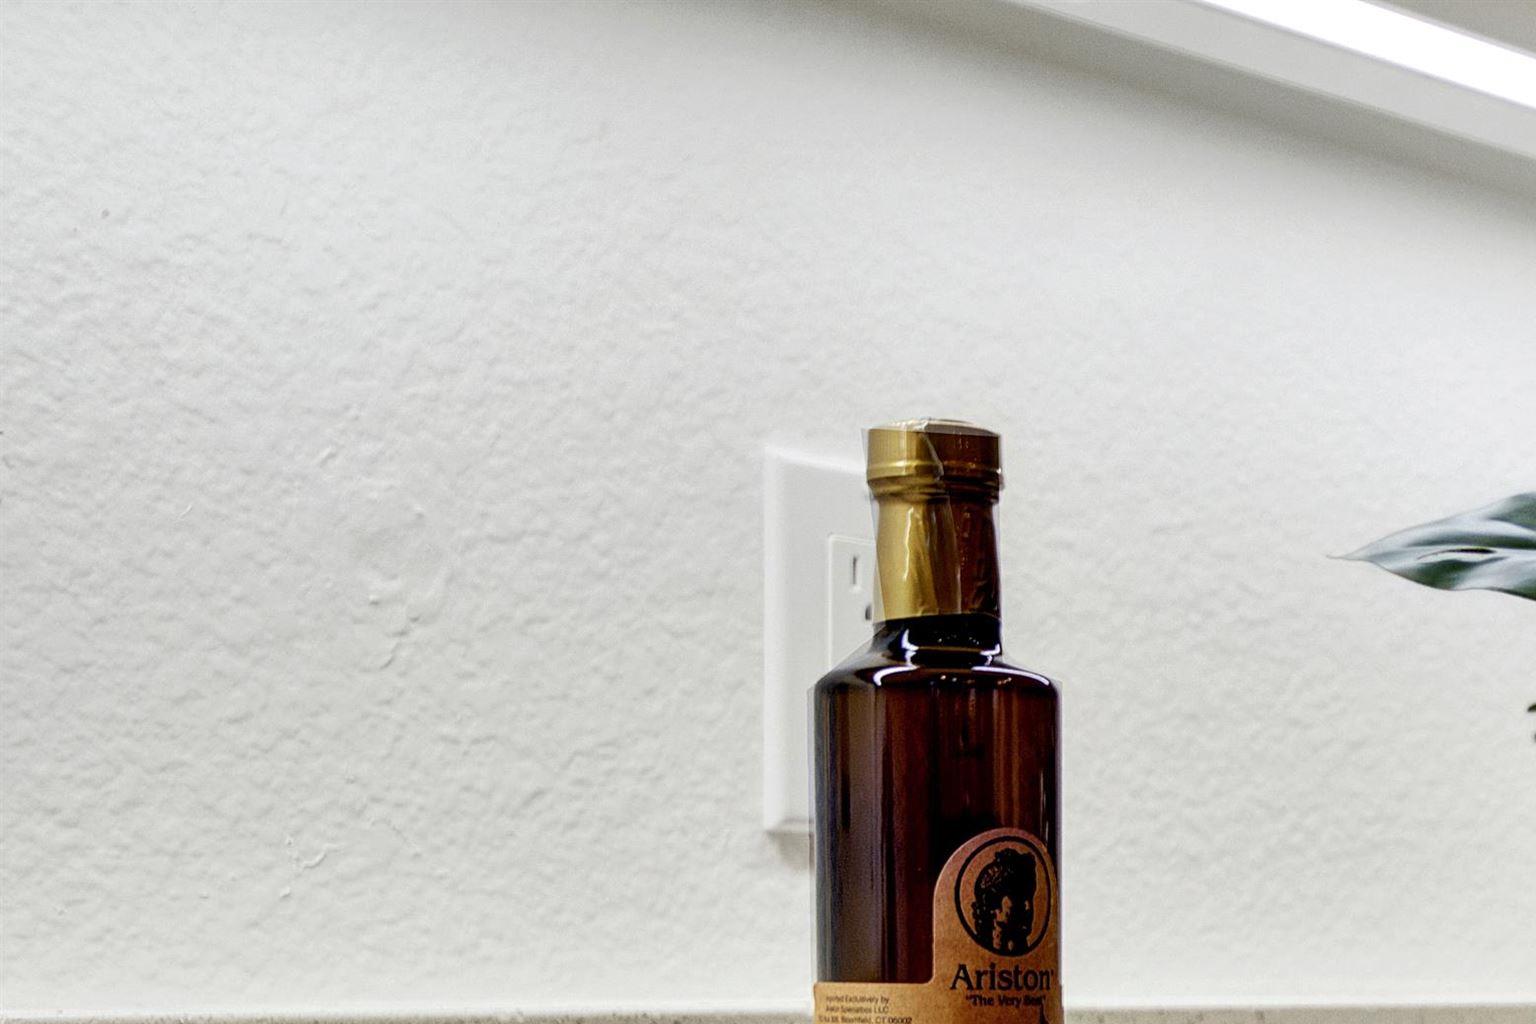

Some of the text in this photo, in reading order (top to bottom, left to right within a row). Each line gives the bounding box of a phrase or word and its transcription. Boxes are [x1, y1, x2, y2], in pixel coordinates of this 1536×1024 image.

[949, 962, 1051, 991] Ariston
[880, 995, 890, 1005] by
[997, 995, 1021, 1008] Very
[874, 1006, 889, 1014] LLC
[875, 1016, 886, 1024] CT
[888, 1016, 913, 1024] 06002
